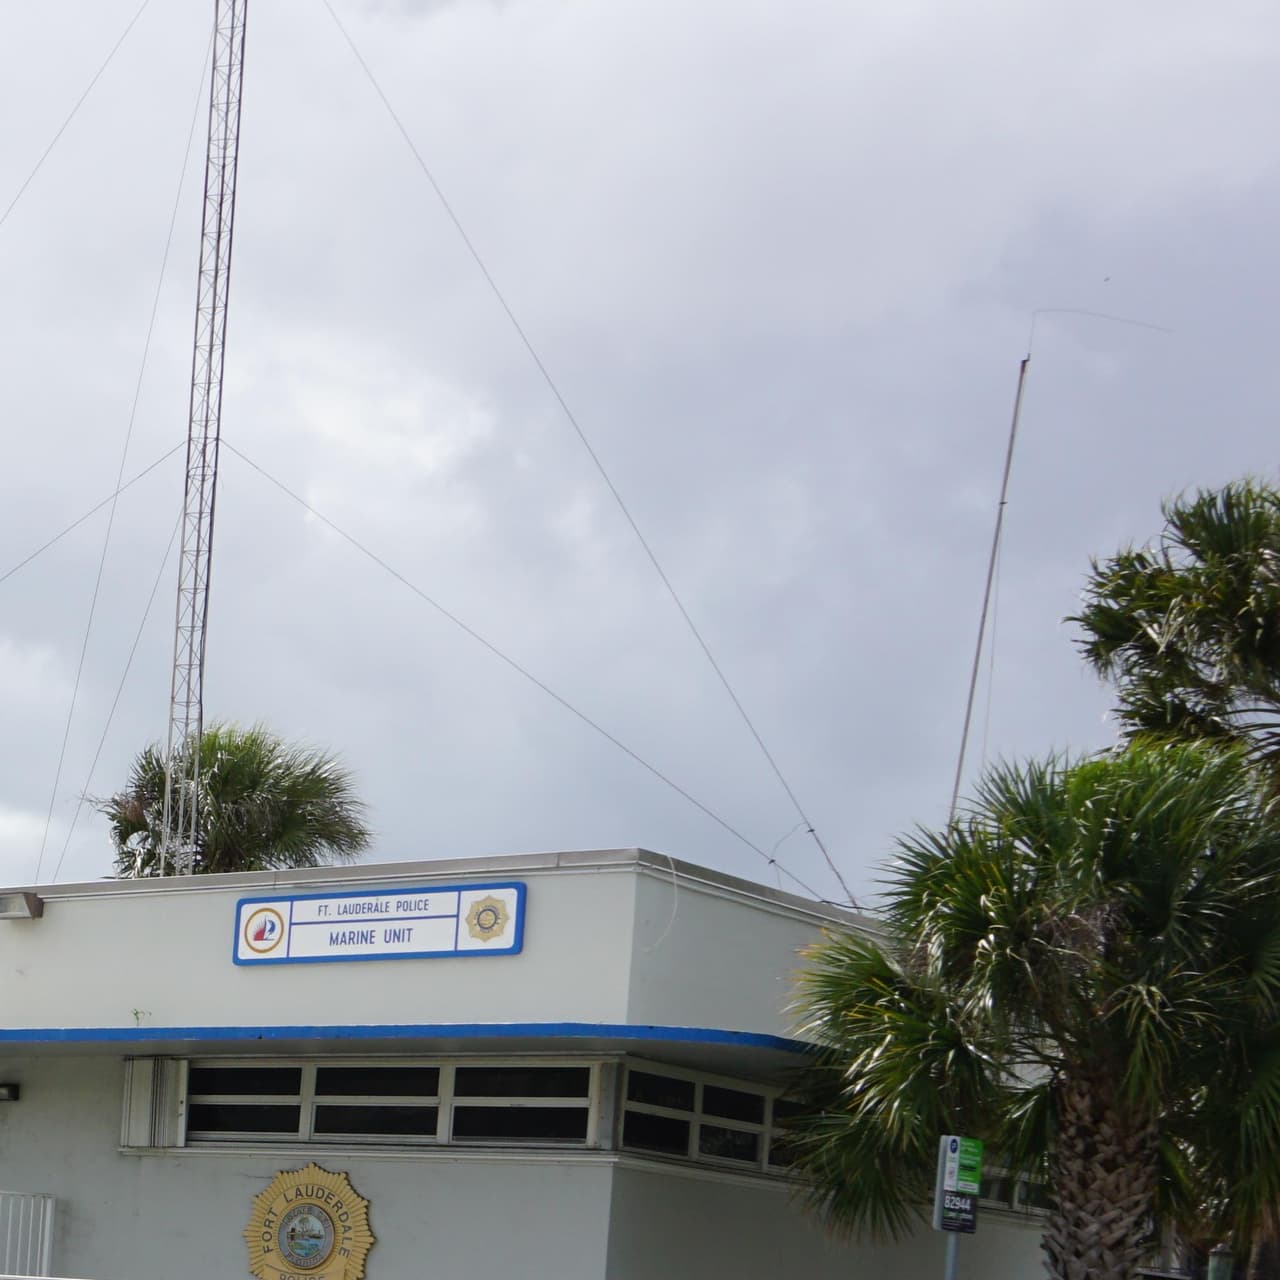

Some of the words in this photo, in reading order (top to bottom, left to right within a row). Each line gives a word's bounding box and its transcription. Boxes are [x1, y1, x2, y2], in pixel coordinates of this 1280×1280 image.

[317, 904, 333, 917] FT.
[337, 901, 390, 916] LAUDERALE
[396, 898, 430, 912] POLICE
[329, 929, 376, 946] MARINE
[383, 927, 414, 944] UNIT
[944, 1195, 972, 1211] 82944
[261, 1206, 279, 1255] FORT
[283, 1184, 353, 1259] LAUDERDALE
